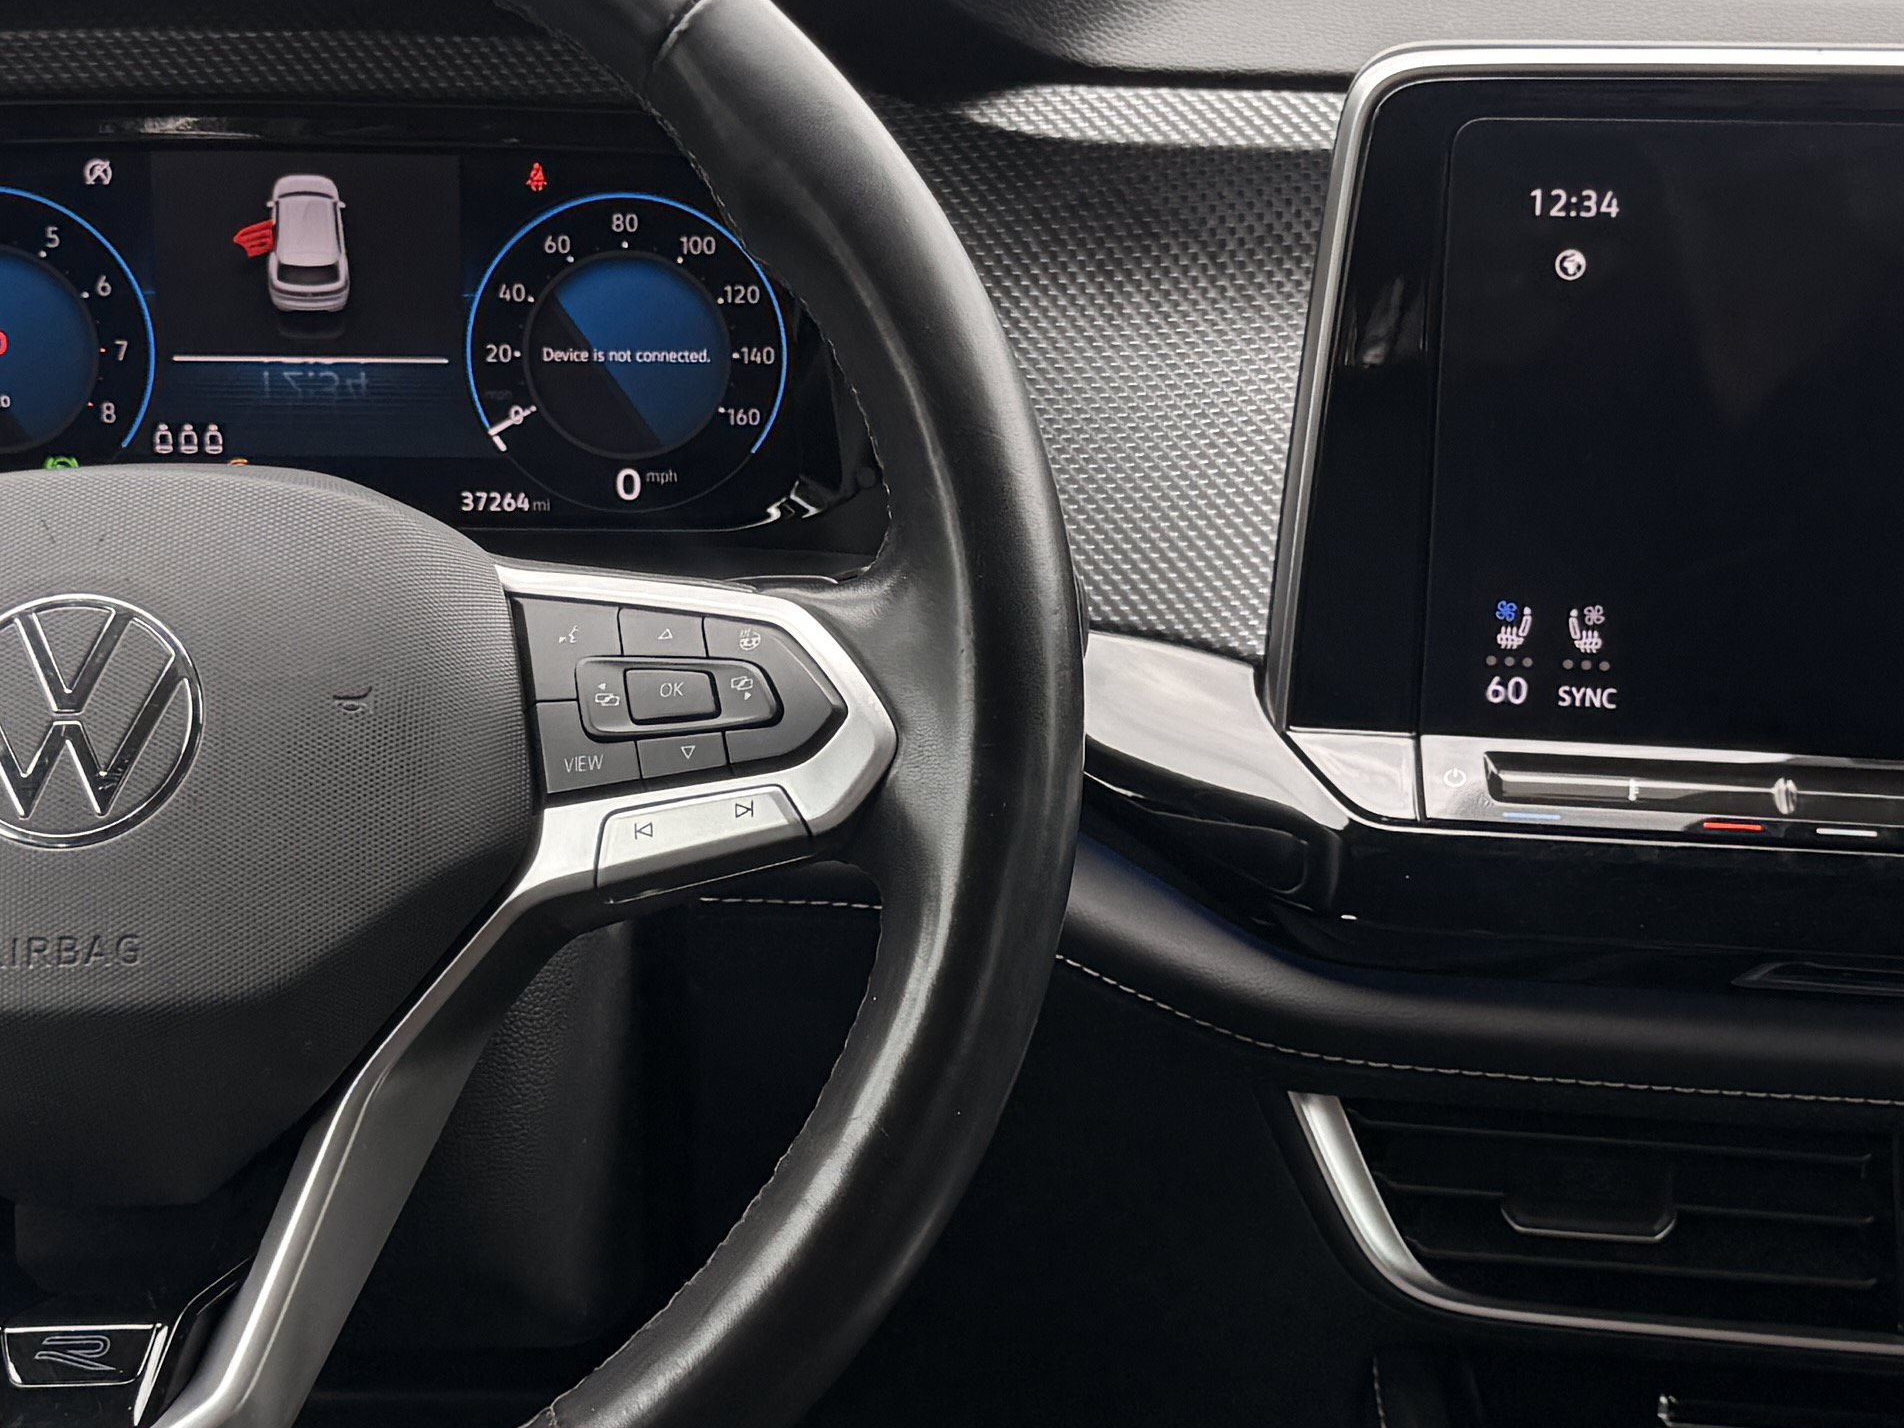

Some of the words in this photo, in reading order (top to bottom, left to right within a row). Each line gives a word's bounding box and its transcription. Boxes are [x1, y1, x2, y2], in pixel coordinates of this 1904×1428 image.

[1531, 189, 1619, 217] 12:34
[612, 213, 638, 232] 80
[47, 227, 59, 247] 5
[545, 236, 570, 254] 60
[680, 236, 715, 254] 100
[97, 276, 111, 296] 6
[499, 284, 525, 301] 40
[725, 285, 759, 304] 120
[115, 341, 127, 361] 7
[487, 344, 511, 362] 20
[541, 345, 590, 363] Device
[593, 346, 606, 363] is
[608, 348, 632, 363] not
[635, 348, 711, 364] connected.
[741, 347, 774, 364] 140
[102, 403, 116, 423] 8
[728, 409, 760, 425] 160
[617, 469, 640, 500] 0
[645, 468, 679, 486] mph
[462, 492, 529, 511] 37264
[532, 498, 552, 513] mi
[660, 682, 684, 697] OK
[1486, 676, 1527, 704] 60
[1558, 686, 1617, 709] SYNC
[565, 755, 603, 772] VIEW
[34, 1334, 117, 1371] R
